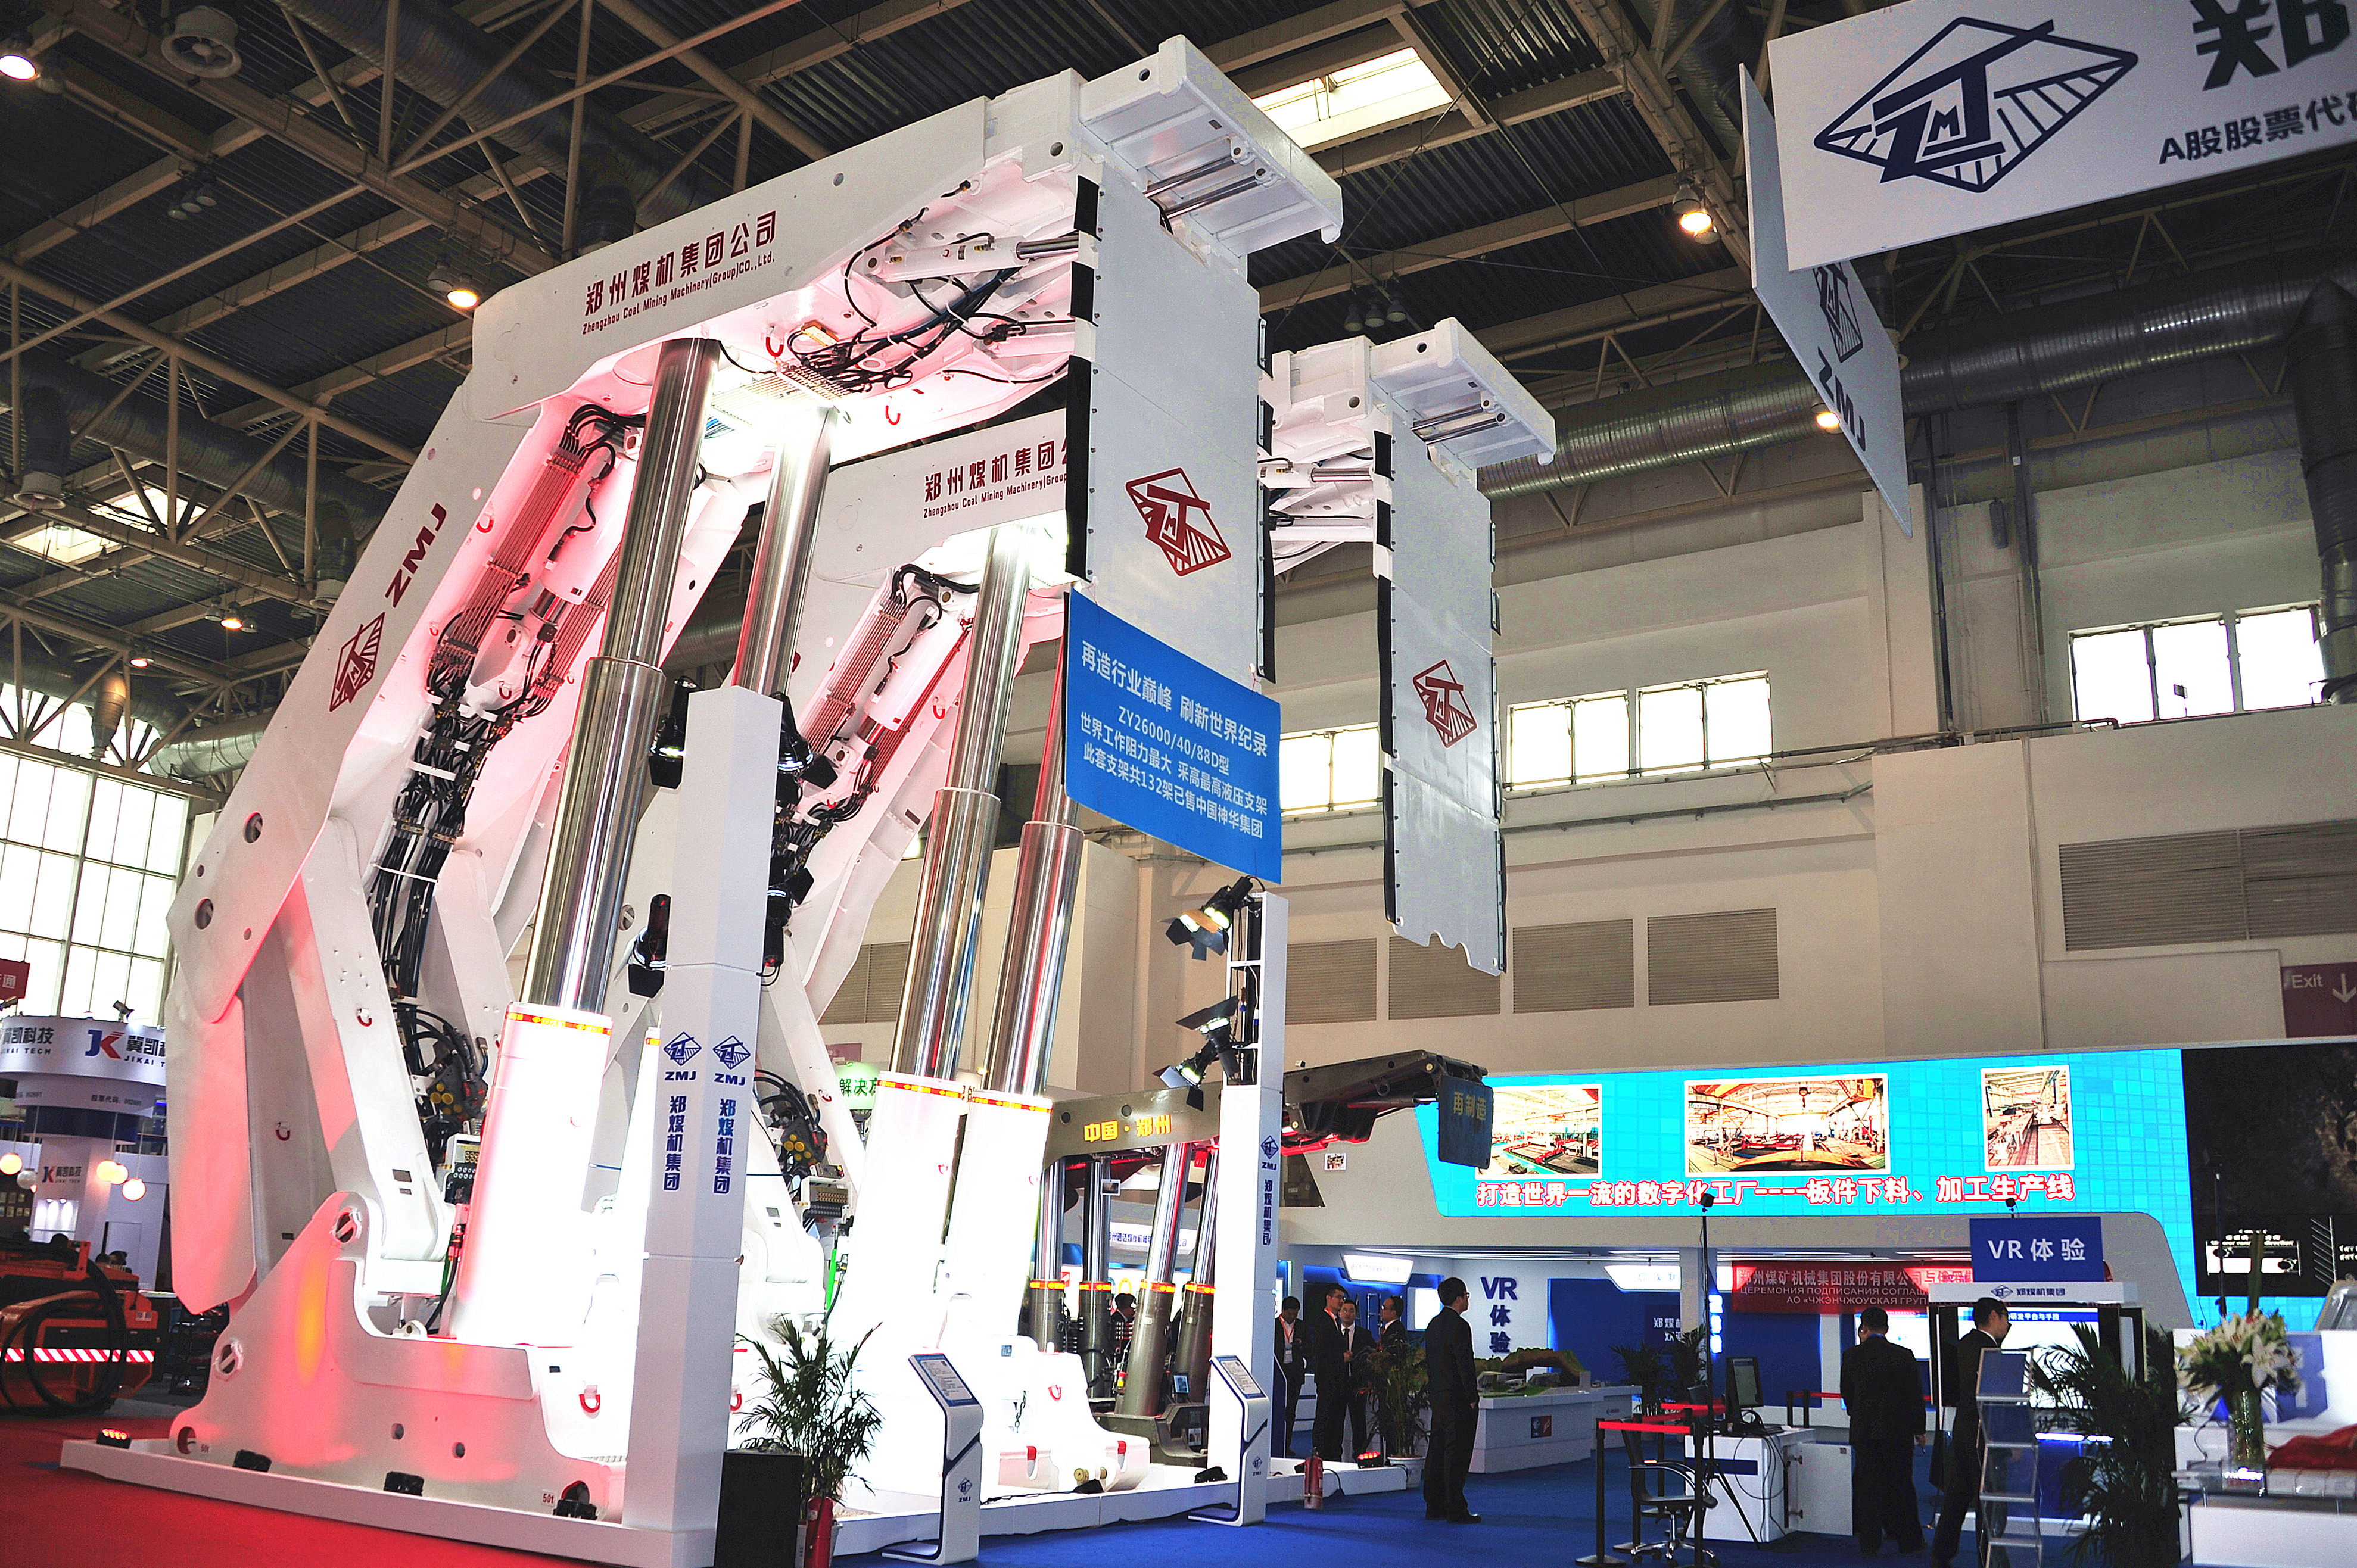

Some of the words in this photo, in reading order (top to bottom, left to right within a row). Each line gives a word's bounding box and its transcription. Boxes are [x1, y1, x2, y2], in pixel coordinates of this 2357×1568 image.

[585, 210, 776, 316] 郑州煤机集团公司
[583, 314, 619, 335] Zhengzhou
[623, 304, 640, 319] Coal
[643, 294, 667, 310] Mining
[923, 501, 959, 518] Zhengzhou
[962, 495, 977, 508] Coal
[981, 490, 1003, 503] Mining
[385, 503, 446, 607] ZMJ
[1082, 640, 1172, 712] 再造行业巅峰
[1179, 694, 1268, 757] 刷新世界纪录
[1118, 706, 1229, 775] ZY26000/40/88D型
[1081, 712, 1172, 774] 世界工作阻力最大
[1178, 760, 1268, 816] 采高最高液压支架
[1083, 742, 1263, 839] 此套支架共132架已售中国神华集团
[2291, 973, 2323, 989] Exit
[124, 1056, 154, 1066] JIKAI
[664, 1071, 696, 1081] ZMJ
[714, 1073, 745, 1086] ZMJ
[1453, 1091, 1486, 1121] 再制造
[1084, 1114, 1172, 1142] 中国·郑州
[663, 1095, 687, 1191] 郑煤机集团
[713, 1098, 736, 1194] 郑煤机集团
[1262, 1162, 1277, 1171] ZMJ
[1262, 1179, 1273, 1246] 郑煤机集团
[1988, 1240, 2023, 1259] VR
[1480, 1277, 1518, 1300] VR
[1740, 1286, 1805, 1295] ЦЕРЕМОНИЯ
[1807, 1287, 1879, 1296] ПОДПИСАНИЯ
[1885, 1288, 1928, 1296] СОГЛАШ
[1804, 1296, 1898, 1305] «ЧЖЭНЧЖОУСКАЯ
[2016, 1288, 2066, 1296] 郑煤机集团
[1489, 1304, 1511, 1353] 体验
[2009, 1313, 2059, 1321] 研发平台与手段
[543, 1493, 555, 1504] 50t
